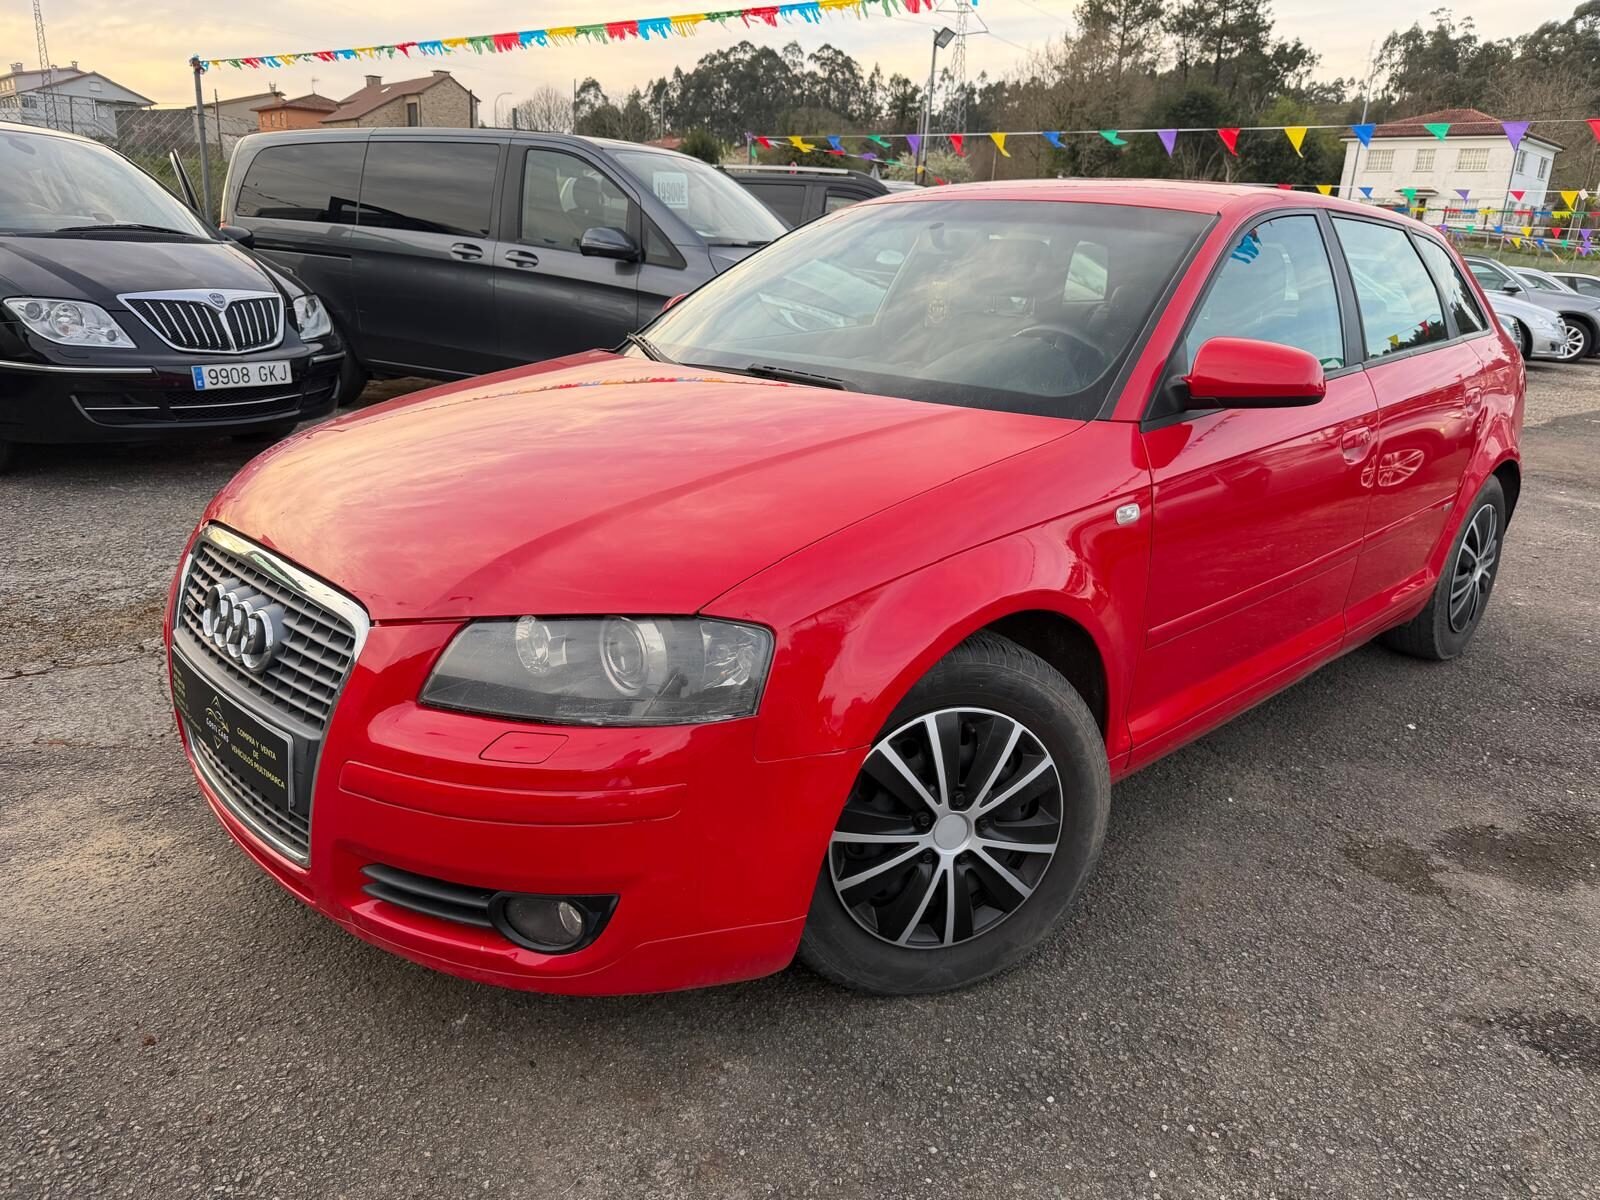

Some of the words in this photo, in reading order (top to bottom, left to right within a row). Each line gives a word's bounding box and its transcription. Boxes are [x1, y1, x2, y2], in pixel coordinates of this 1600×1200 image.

[208, 367, 251, 385] 9908
[259, 365, 287, 382] GKJ
[237, 727, 256, 747] COMPRA
[256, 740, 260, 749] Y
[260, 743, 277, 760] VENTA
[252, 749, 259, 760] DE
[253, 761, 286, 790] MULTIMARCA
